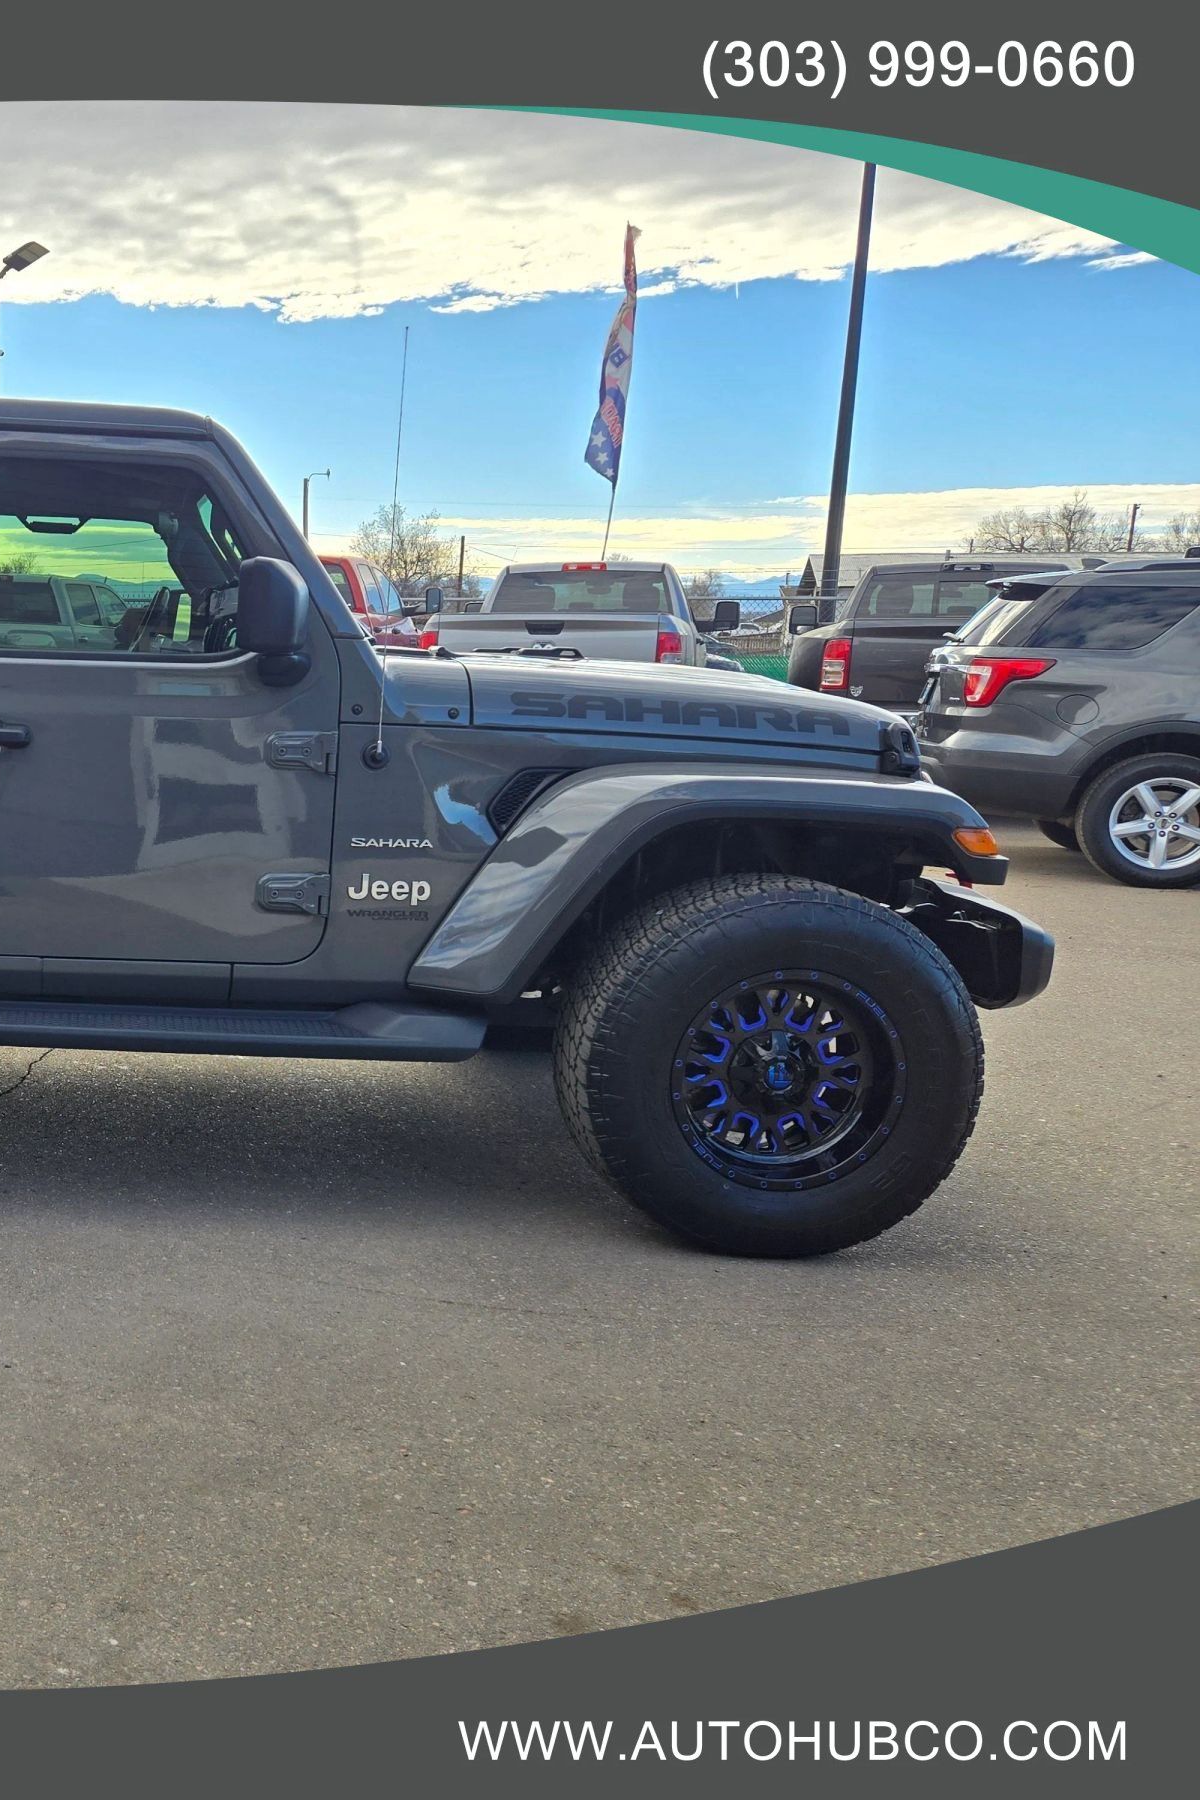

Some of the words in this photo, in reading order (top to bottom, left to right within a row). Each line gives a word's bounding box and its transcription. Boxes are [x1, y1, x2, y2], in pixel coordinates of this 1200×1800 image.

[510, 691, 851, 736] SAHARA
[350, 837, 434, 849] SAHARA
[347, 873, 431, 906] Jeep
[346, 909, 429, 918] WRANGLER
[855, 990, 888, 1026] FUEL
[691, 1135, 724, 1170] FUEL
